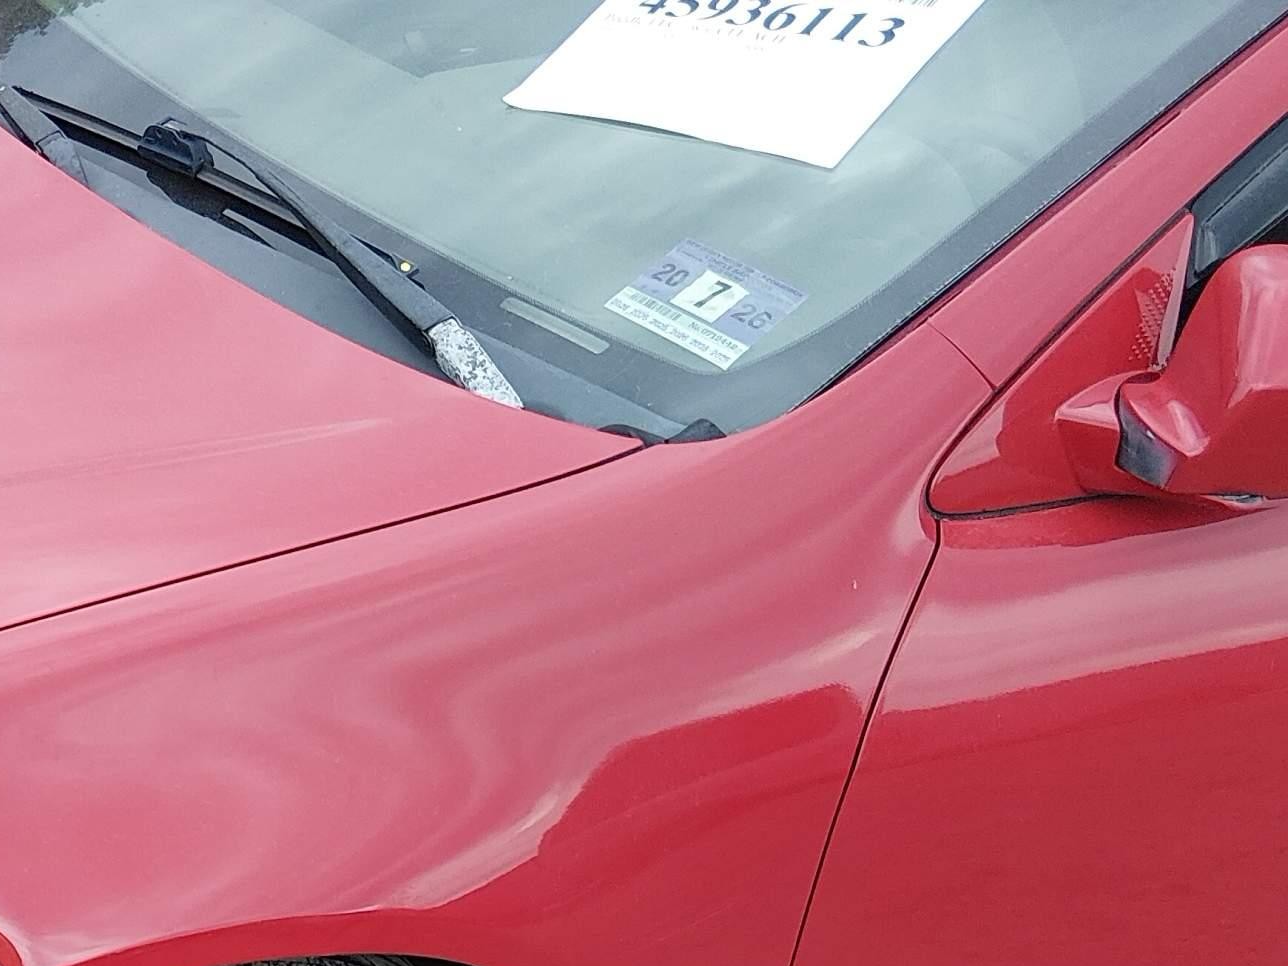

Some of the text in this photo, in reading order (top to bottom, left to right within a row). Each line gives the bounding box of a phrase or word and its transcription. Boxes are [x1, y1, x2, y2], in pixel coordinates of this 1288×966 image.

[651, 263, 690, 287] 20
[694, 280, 732, 309] 7
[730, 302, 774, 329] 26
